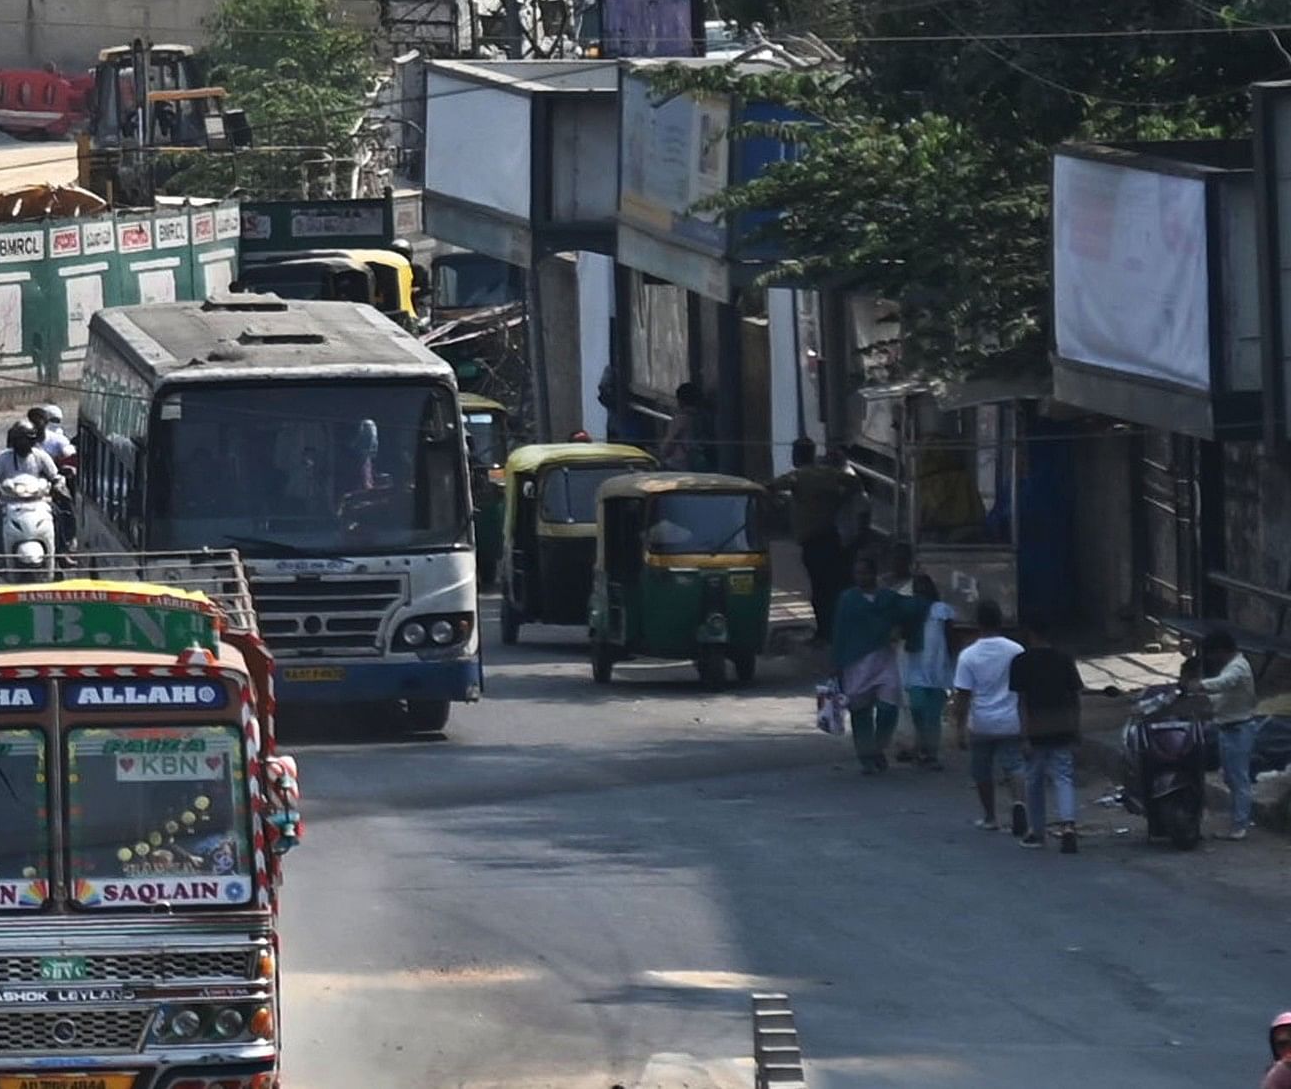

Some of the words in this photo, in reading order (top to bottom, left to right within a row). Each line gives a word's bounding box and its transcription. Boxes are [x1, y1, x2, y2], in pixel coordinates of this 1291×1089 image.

[0, 238, 40, 257] BMRCL
[77, 686, 197, 705] ALLAH
[142, 756, 198, 775] KBN
[103, 881, 219, 902] SAQLAIN
[58, 989, 136, 1002] LEYLAND
